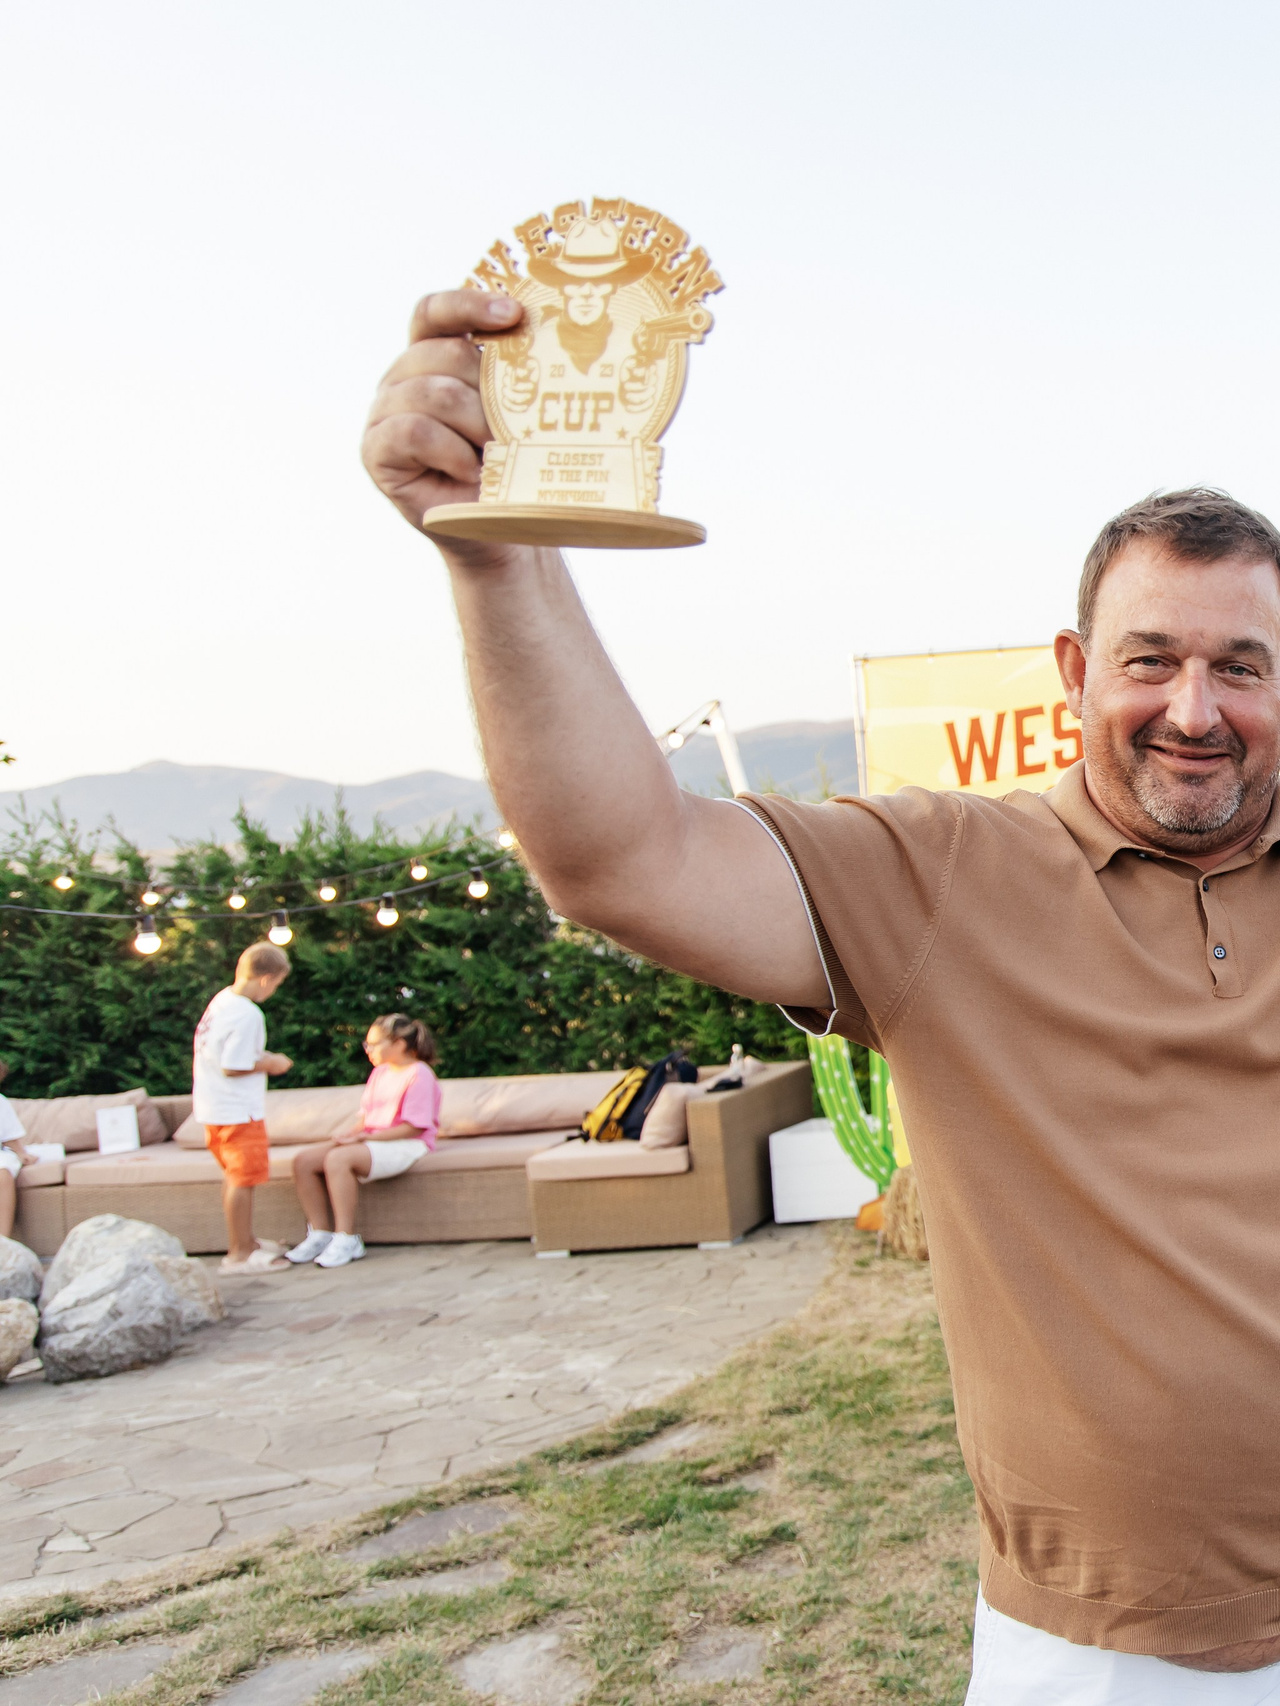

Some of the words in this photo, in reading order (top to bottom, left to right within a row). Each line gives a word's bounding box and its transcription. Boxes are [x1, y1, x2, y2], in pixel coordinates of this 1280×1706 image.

[550, 364, 566, 378] 20
[600, 363, 615, 378] 23
[538, 391, 615, 432] CUP
[540, 469, 554, 482] TO
[559, 469, 582, 482] THE
[586, 469, 610, 483] PIN
